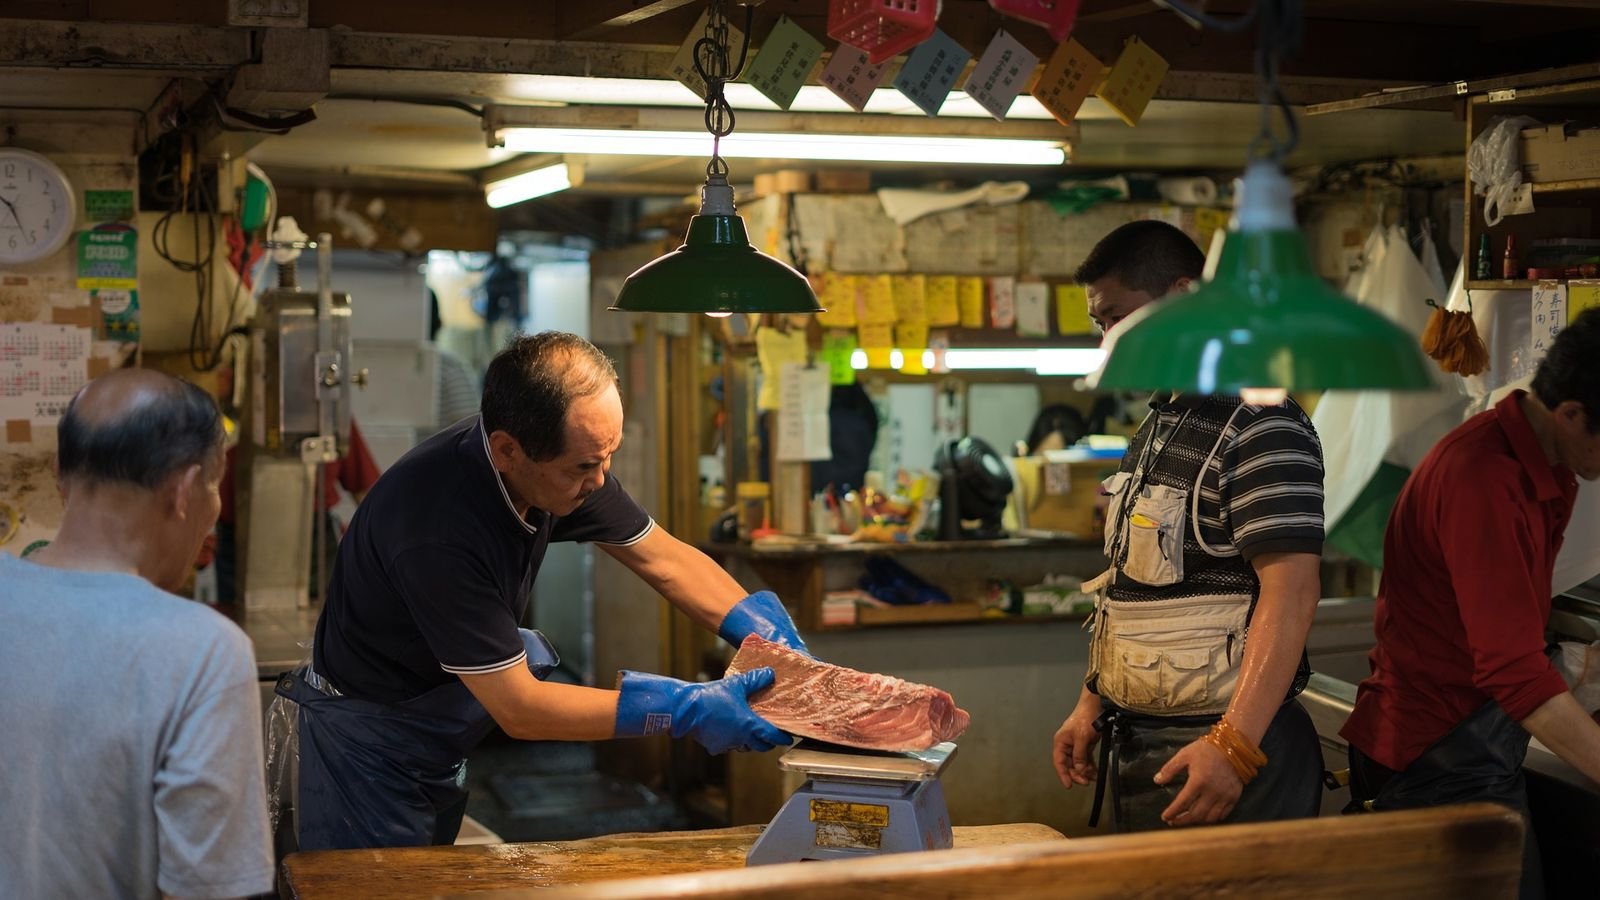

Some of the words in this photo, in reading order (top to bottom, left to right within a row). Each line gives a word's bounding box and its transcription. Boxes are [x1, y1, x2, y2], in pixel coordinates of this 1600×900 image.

[4, 163, 16, 178] 12
[27, 168, 32, 183] 1
[42, 180, 50, 195] 2
[50, 199, 57, 214] 3
[43, 218, 50, 232] 4
[8, 235, 17, 249] 6
[29, 230, 37, 245] 5
